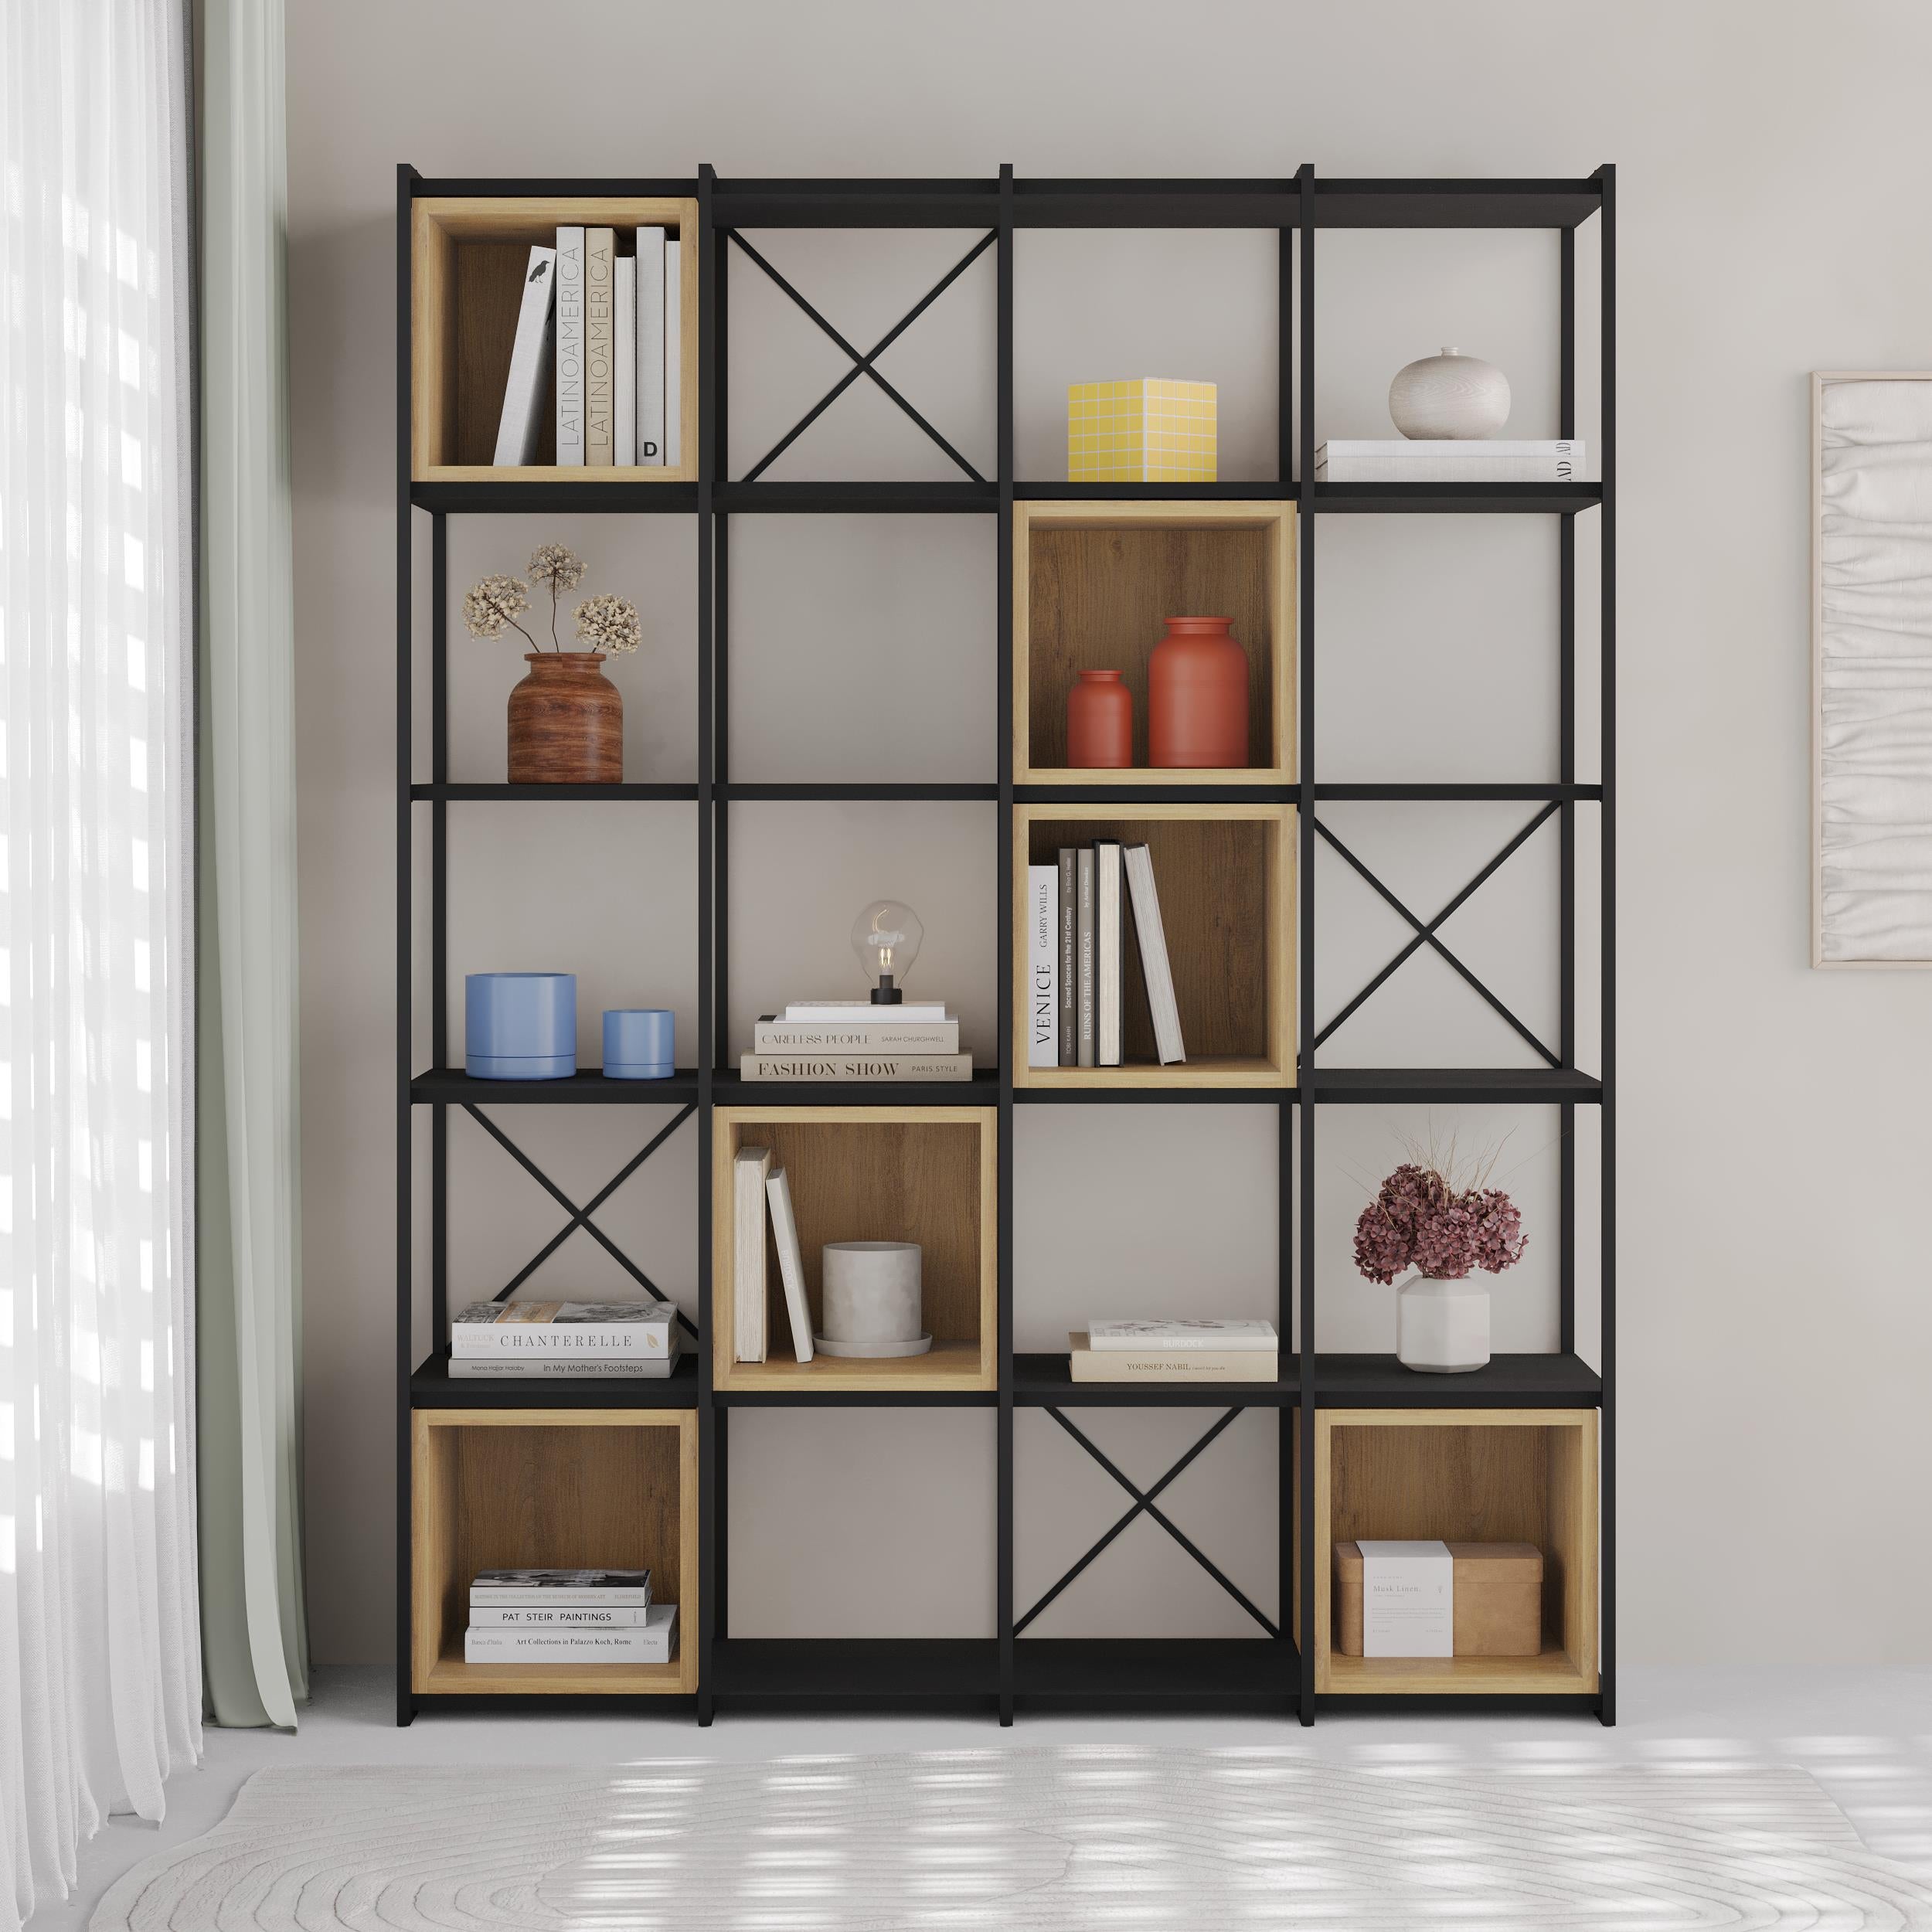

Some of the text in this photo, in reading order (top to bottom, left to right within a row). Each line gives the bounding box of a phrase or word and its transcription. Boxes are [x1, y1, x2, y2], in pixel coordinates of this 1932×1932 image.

[561, 247, 579, 445] LATINOAMERICA
[590, 248, 608, 446] LATINOAMERICA
[644, 442, 657, 457] D
[1036, 884, 1051, 1045] VENICE GARRY WILLS
[1083, 1000, 1091, 1012] OF
[762, 1034, 822, 1044] CARELESS
[826, 1034, 872, 1044] PEOPLE
[758, 1063, 836, 1076] FASHION
[845, 1063, 899, 1076] SHOW
[501, 1335, 631, 1346] CHANTERELLE
[1163, 1339, 1204, 1348] BURDOCK
[553, 1364, 566, 1373] My
[604, 1364, 643, 1373] Footsteps
